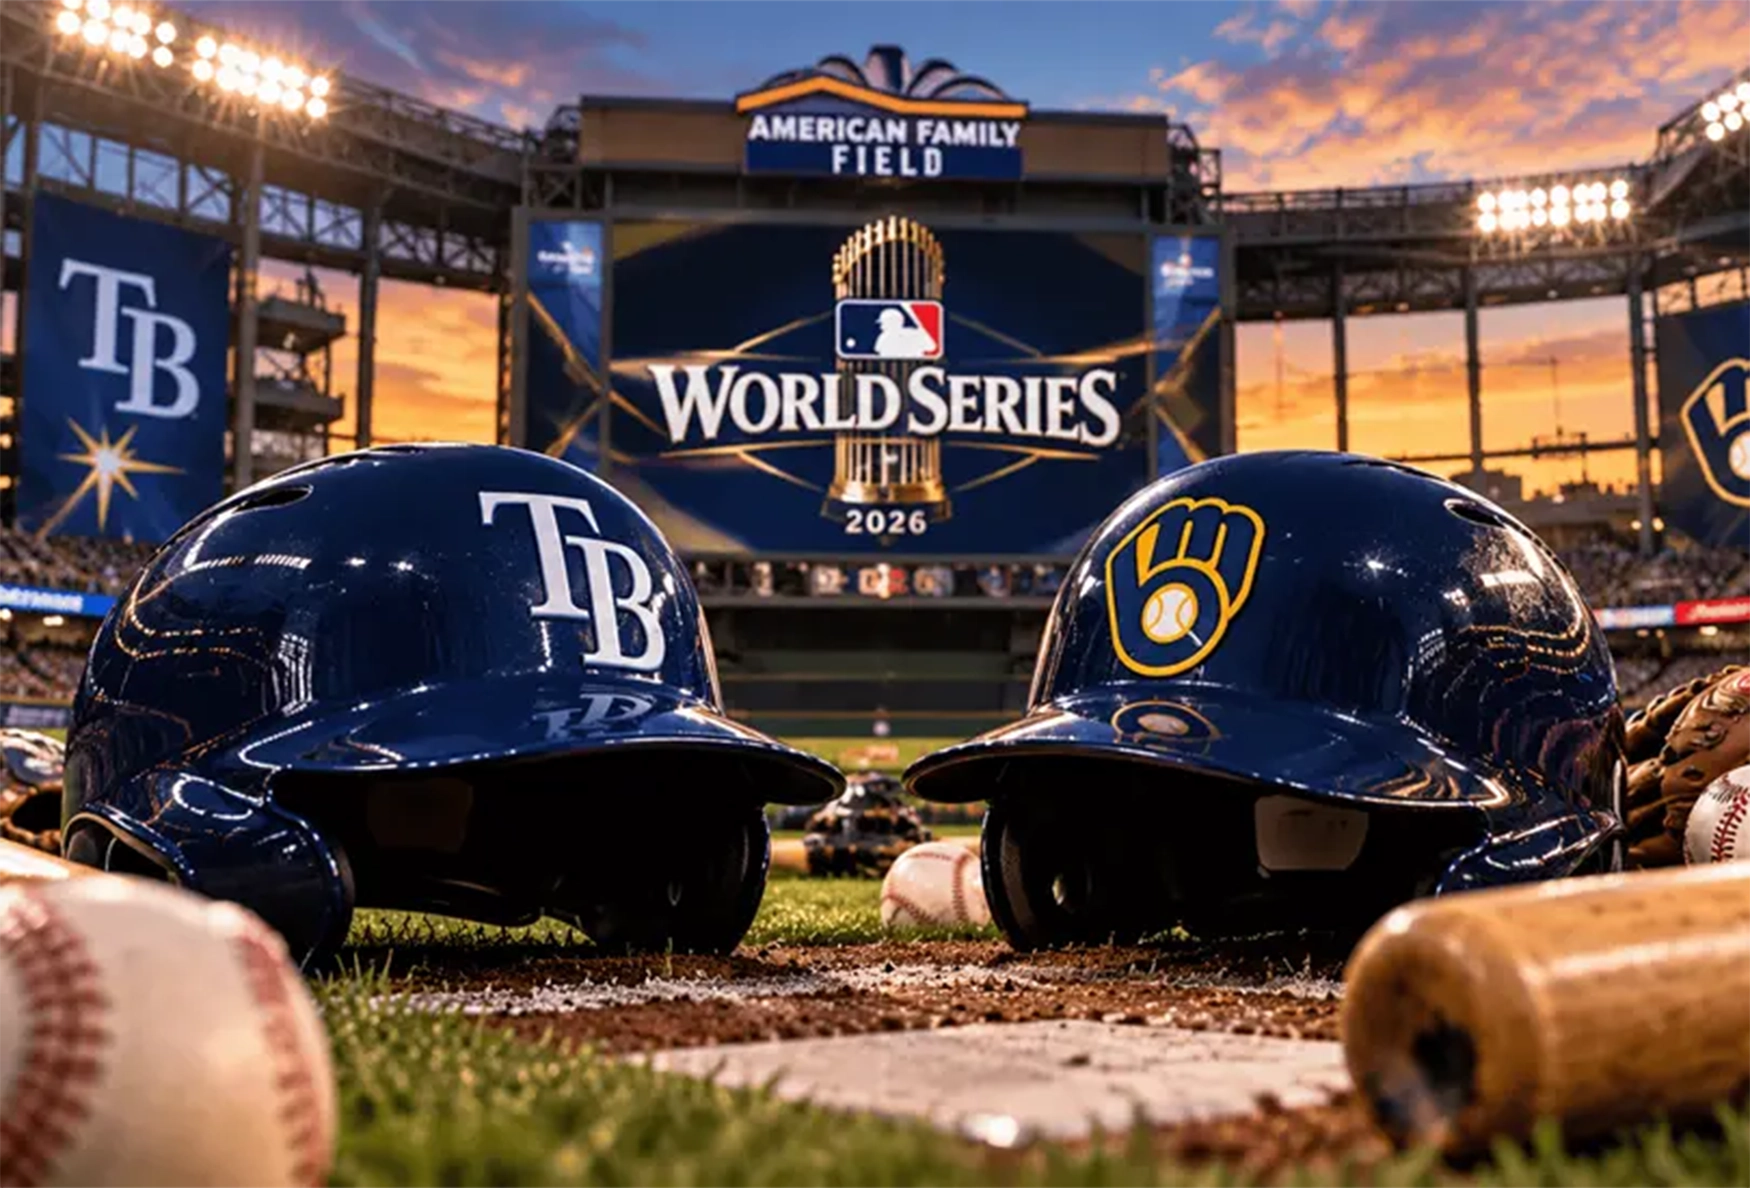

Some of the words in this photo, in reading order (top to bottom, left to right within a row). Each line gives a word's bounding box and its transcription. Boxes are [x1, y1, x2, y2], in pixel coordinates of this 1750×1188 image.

[748, 115, 907, 143] AMERICAN
[916, 119, 1021, 147] FAMILY
[832, 144, 942, 177] FIELD
[59, 258, 200, 419] TB
[647, 364, 901, 444] WORLD
[907, 365, 1121, 447] SERIES
[845, 509, 927, 534] 2026
[478, 491, 666, 671] TB
